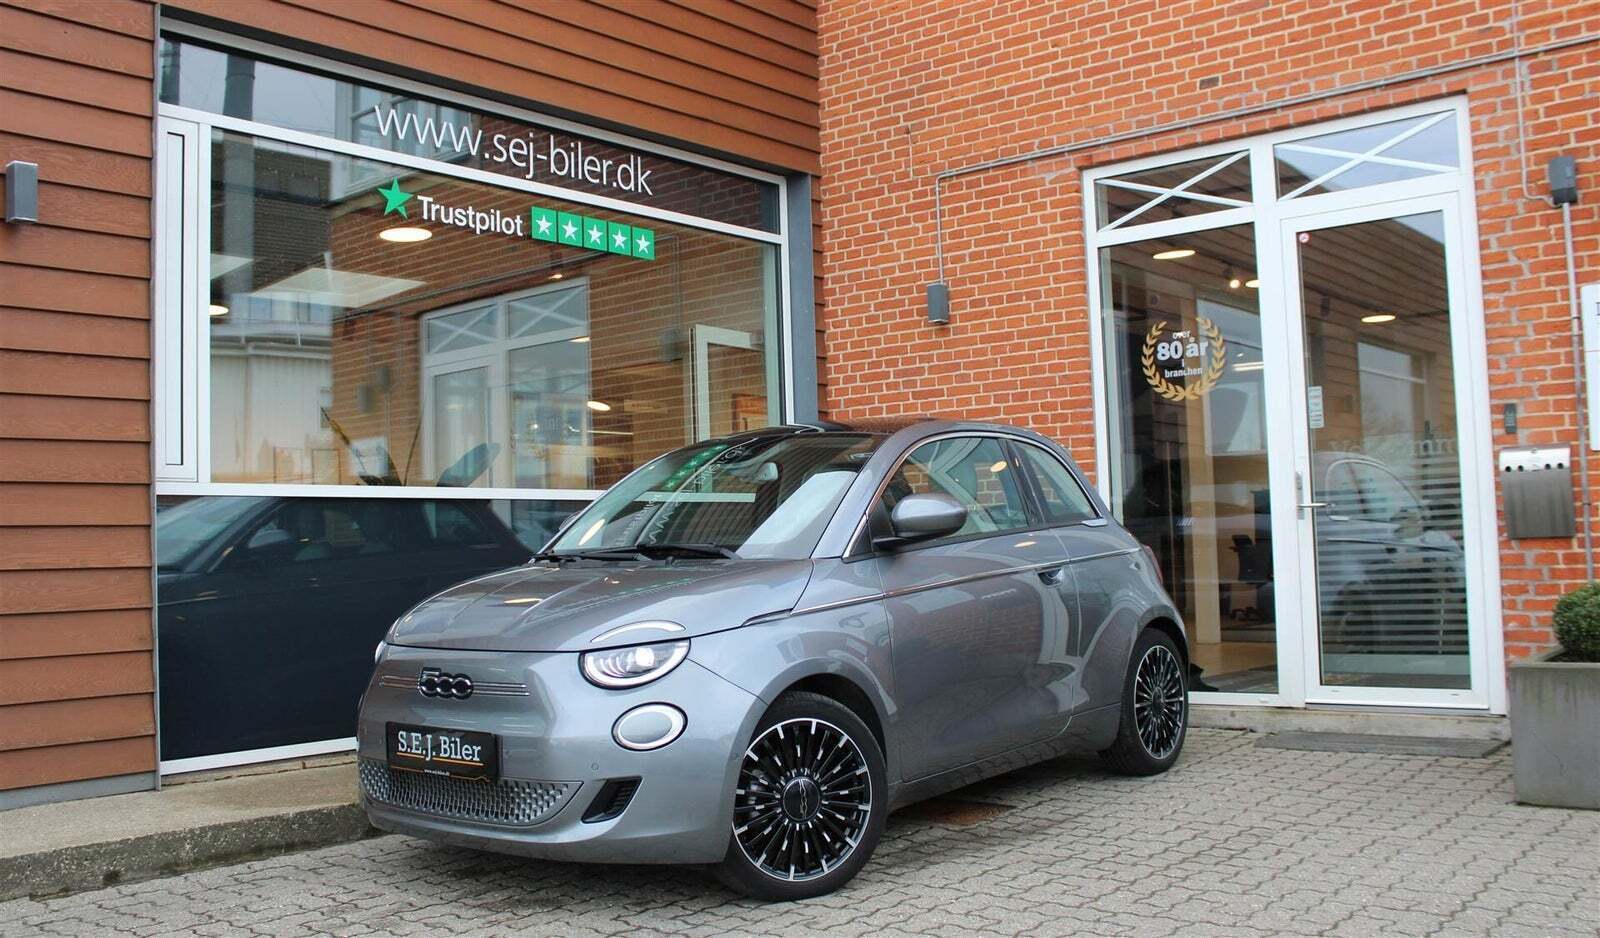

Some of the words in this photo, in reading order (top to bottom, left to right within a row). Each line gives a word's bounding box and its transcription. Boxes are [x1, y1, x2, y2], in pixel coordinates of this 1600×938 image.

[374, 105, 653, 195] www.sej-biler.dk
[417, 194, 524, 236] Trustpilot
[1157, 341, 1183, 360] 80
[1186, 337, 1208, 357] år
[420, 667, 474, 699] 500
[398, 731, 436, 761] S.E.J.
[439, 736, 481, 761] Biler
